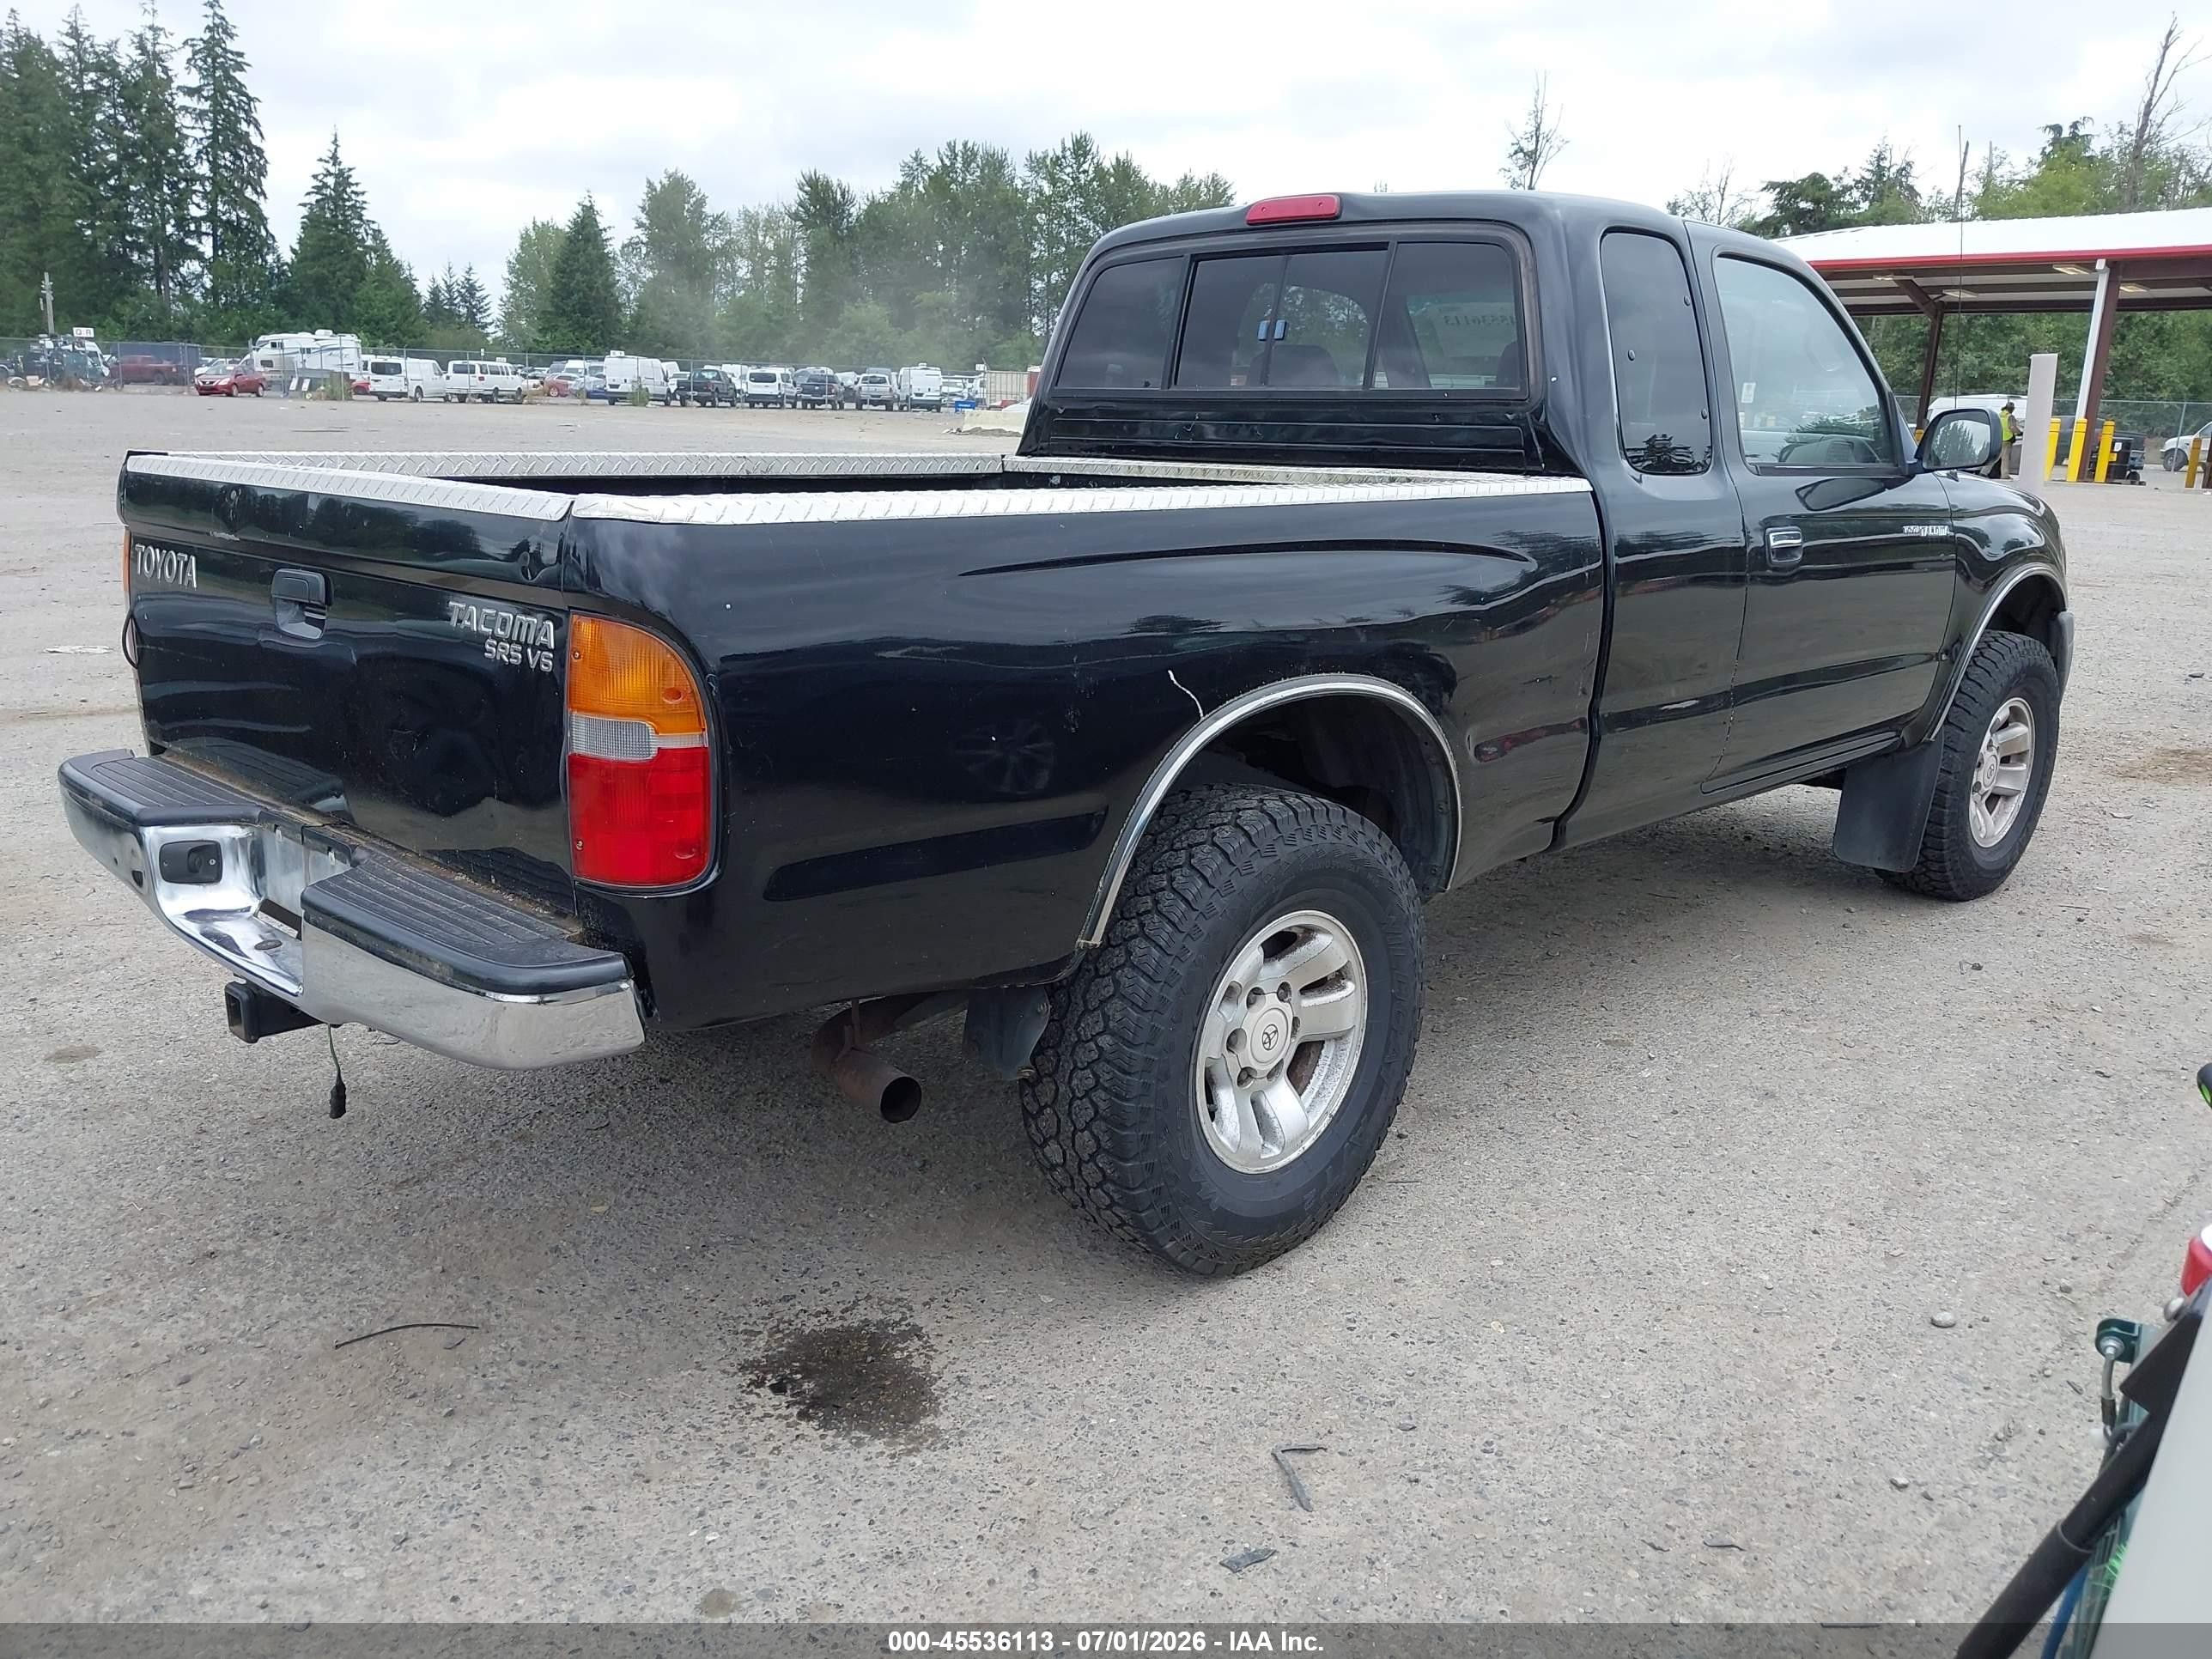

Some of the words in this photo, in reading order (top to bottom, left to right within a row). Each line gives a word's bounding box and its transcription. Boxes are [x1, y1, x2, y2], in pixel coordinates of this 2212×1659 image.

[135, 543, 198, 589] TOYOTA
[448, 600, 555, 649] TACOMA
[526, 647, 555, 672] V6
